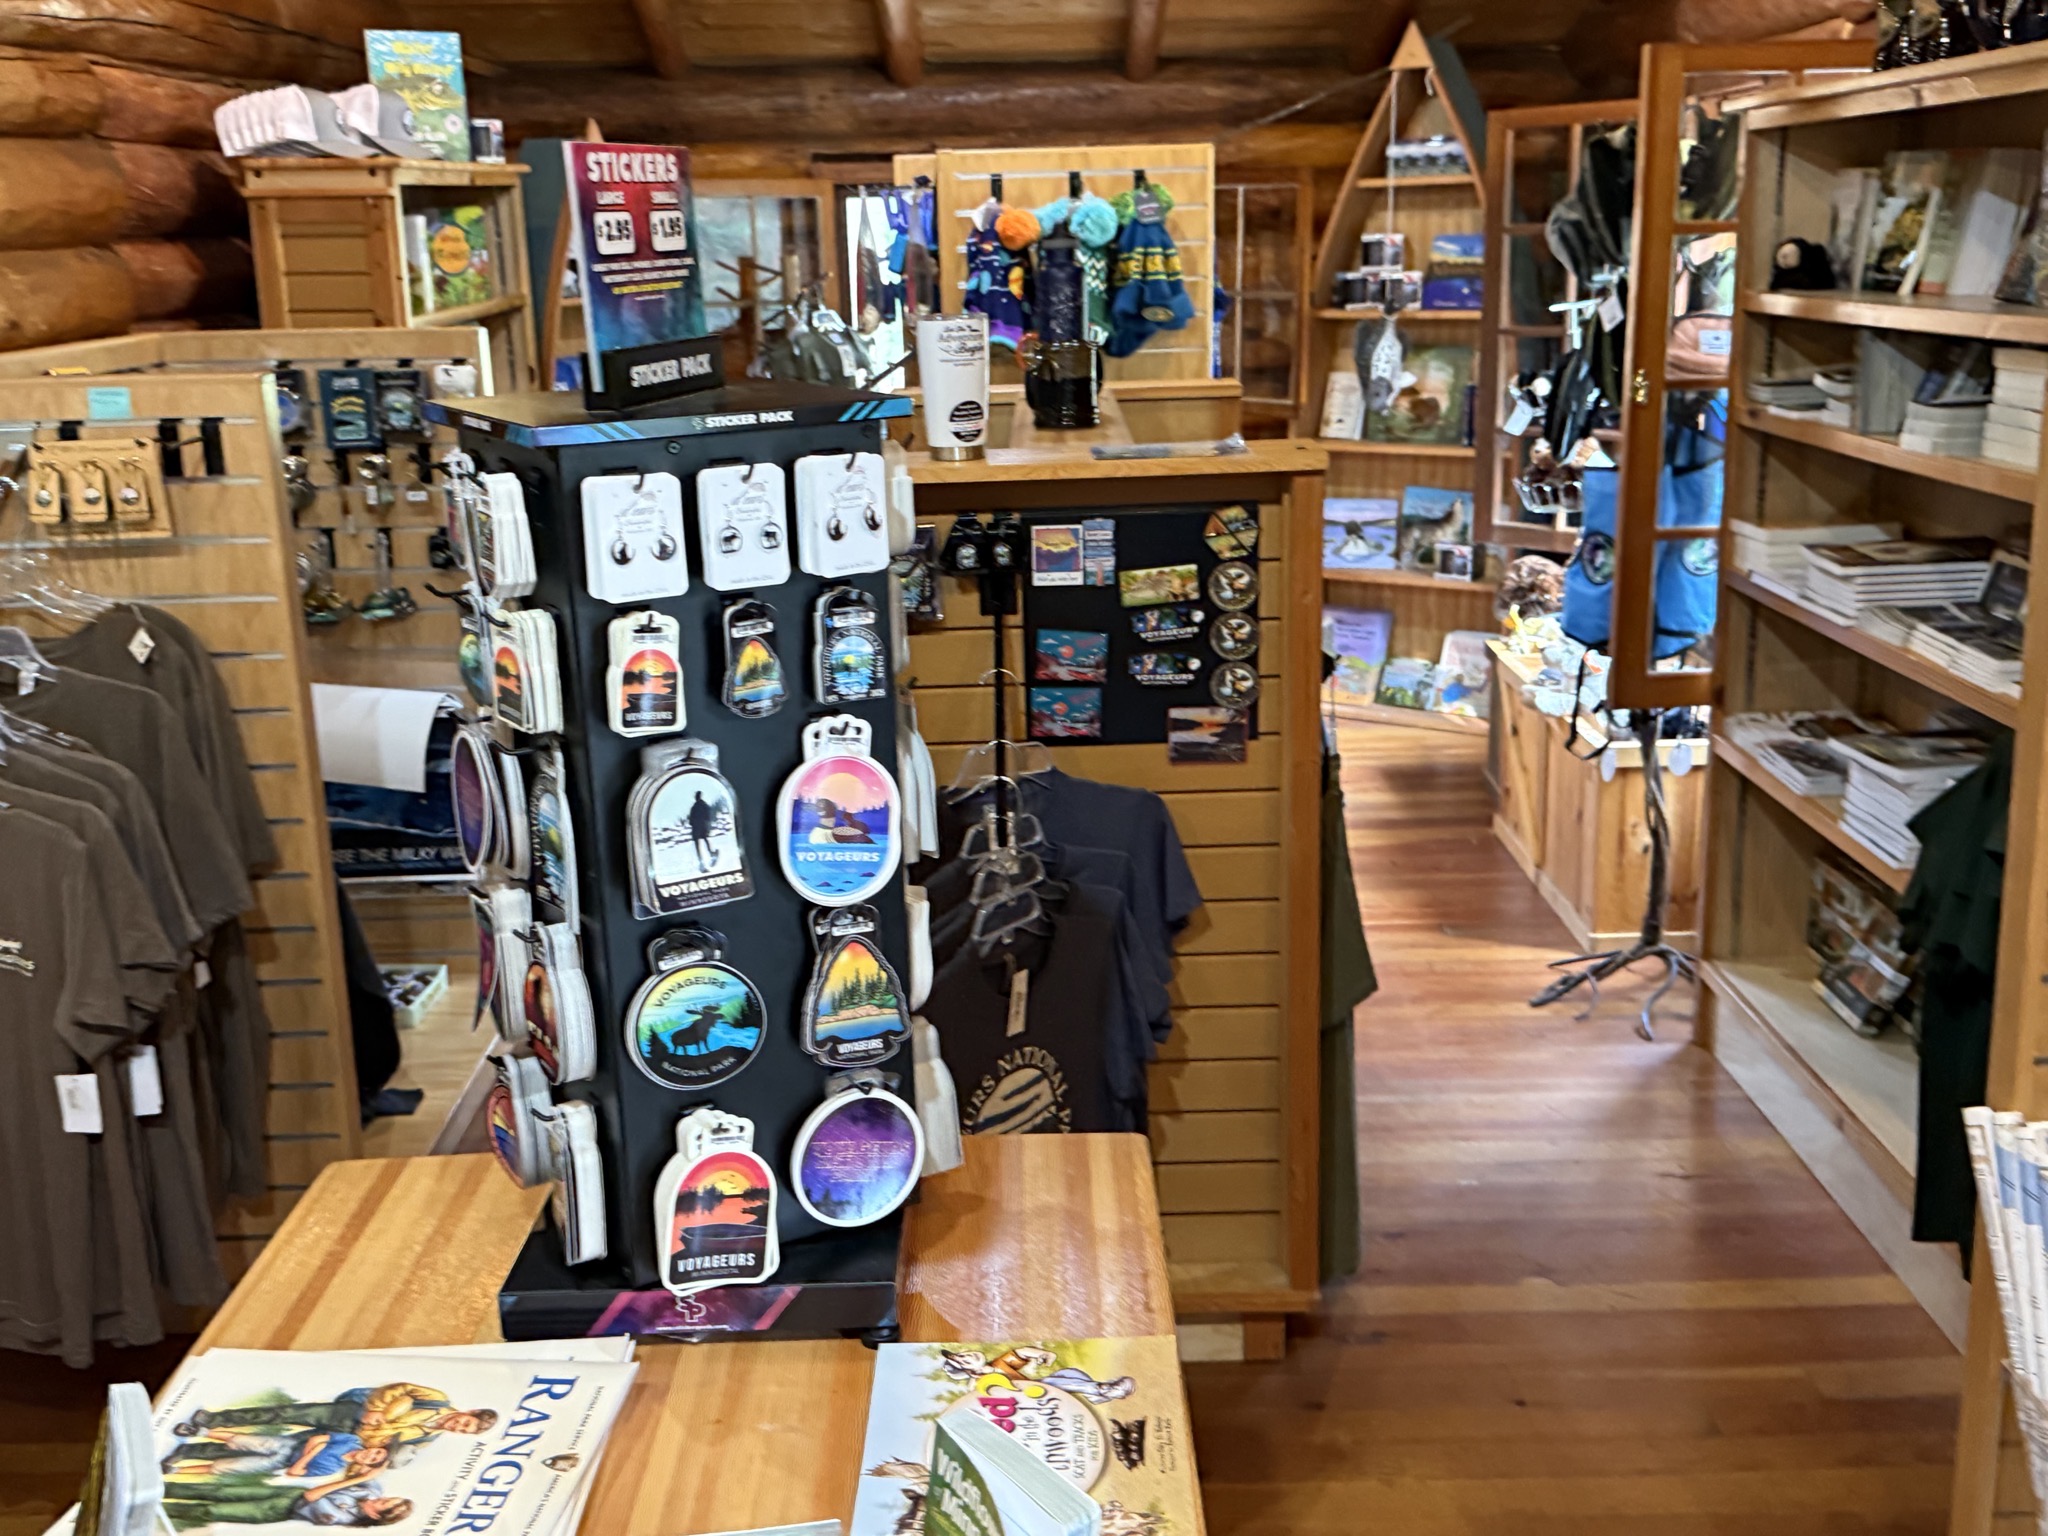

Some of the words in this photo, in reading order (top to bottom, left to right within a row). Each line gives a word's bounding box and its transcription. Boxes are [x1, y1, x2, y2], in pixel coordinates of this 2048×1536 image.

[586, 152, 679, 183] STICKERS
[596, 191, 626, 205] LARGE
[629, 359, 681, 388] STICKER
[681, 353, 713, 378] PACK
[704, 413, 758, 428] STICKER
[758, 411, 794, 423] PACK
[1139, 626, 1199, 639] VOYAGEURS
[1135, 673, 1195, 682] VOYAGEURS
[391, 847, 440, 861] MILKY
[795, 851, 881, 862] VOYAGEURS
[658, 872, 745, 898] VOYAGEURS
[655, 976, 728, 1007] VOYAGEURS
[836, 1038, 884, 1054] VOYAGEURS
[997, 1046, 1069, 1103] NATIONAL
[677, 1252, 756, 1273] VOYAGEURS
[1071, 1414, 1086, 1444] TRACKS
[443, 1374, 582, 1536] RANGER
[455, 1441, 488, 1480] ACTIVITY
[1072, 1459, 1086, 1479] SCAT
[423, 1493, 458, 1526] STICKER
